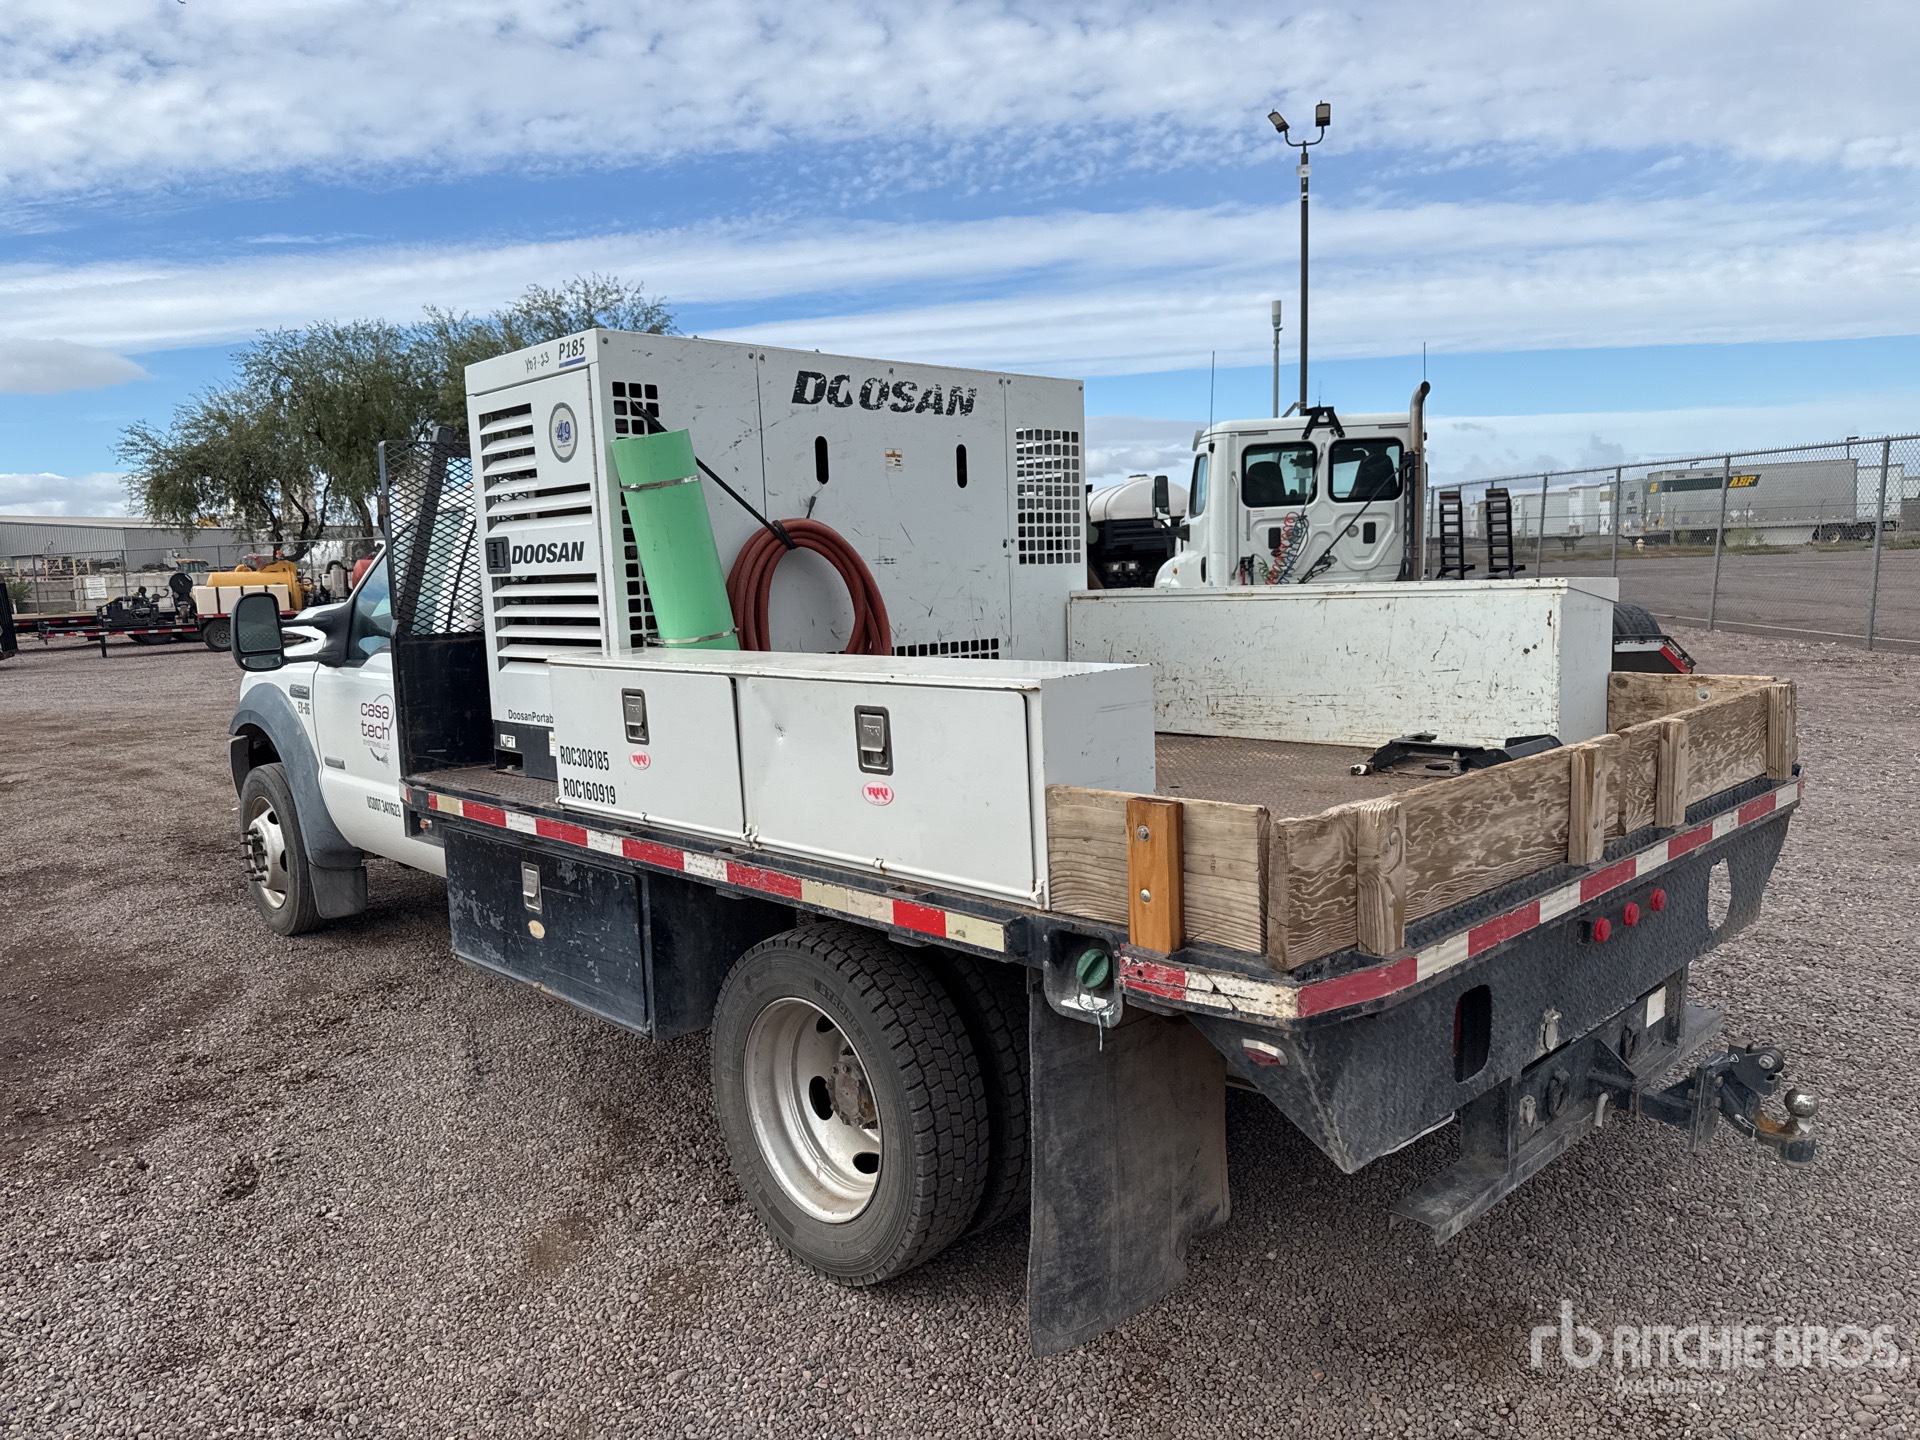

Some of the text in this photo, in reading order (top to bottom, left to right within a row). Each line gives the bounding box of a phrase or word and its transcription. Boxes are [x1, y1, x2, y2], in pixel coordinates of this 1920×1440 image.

[558, 337, 585, 360] P185
[511, 541, 585, 564] DOOSAN
[361, 703, 389, 719] casa
[361, 720, 390, 740] tech
[559, 745, 610, 771] ROC308185
[562, 777, 616, 805] ROC160919
